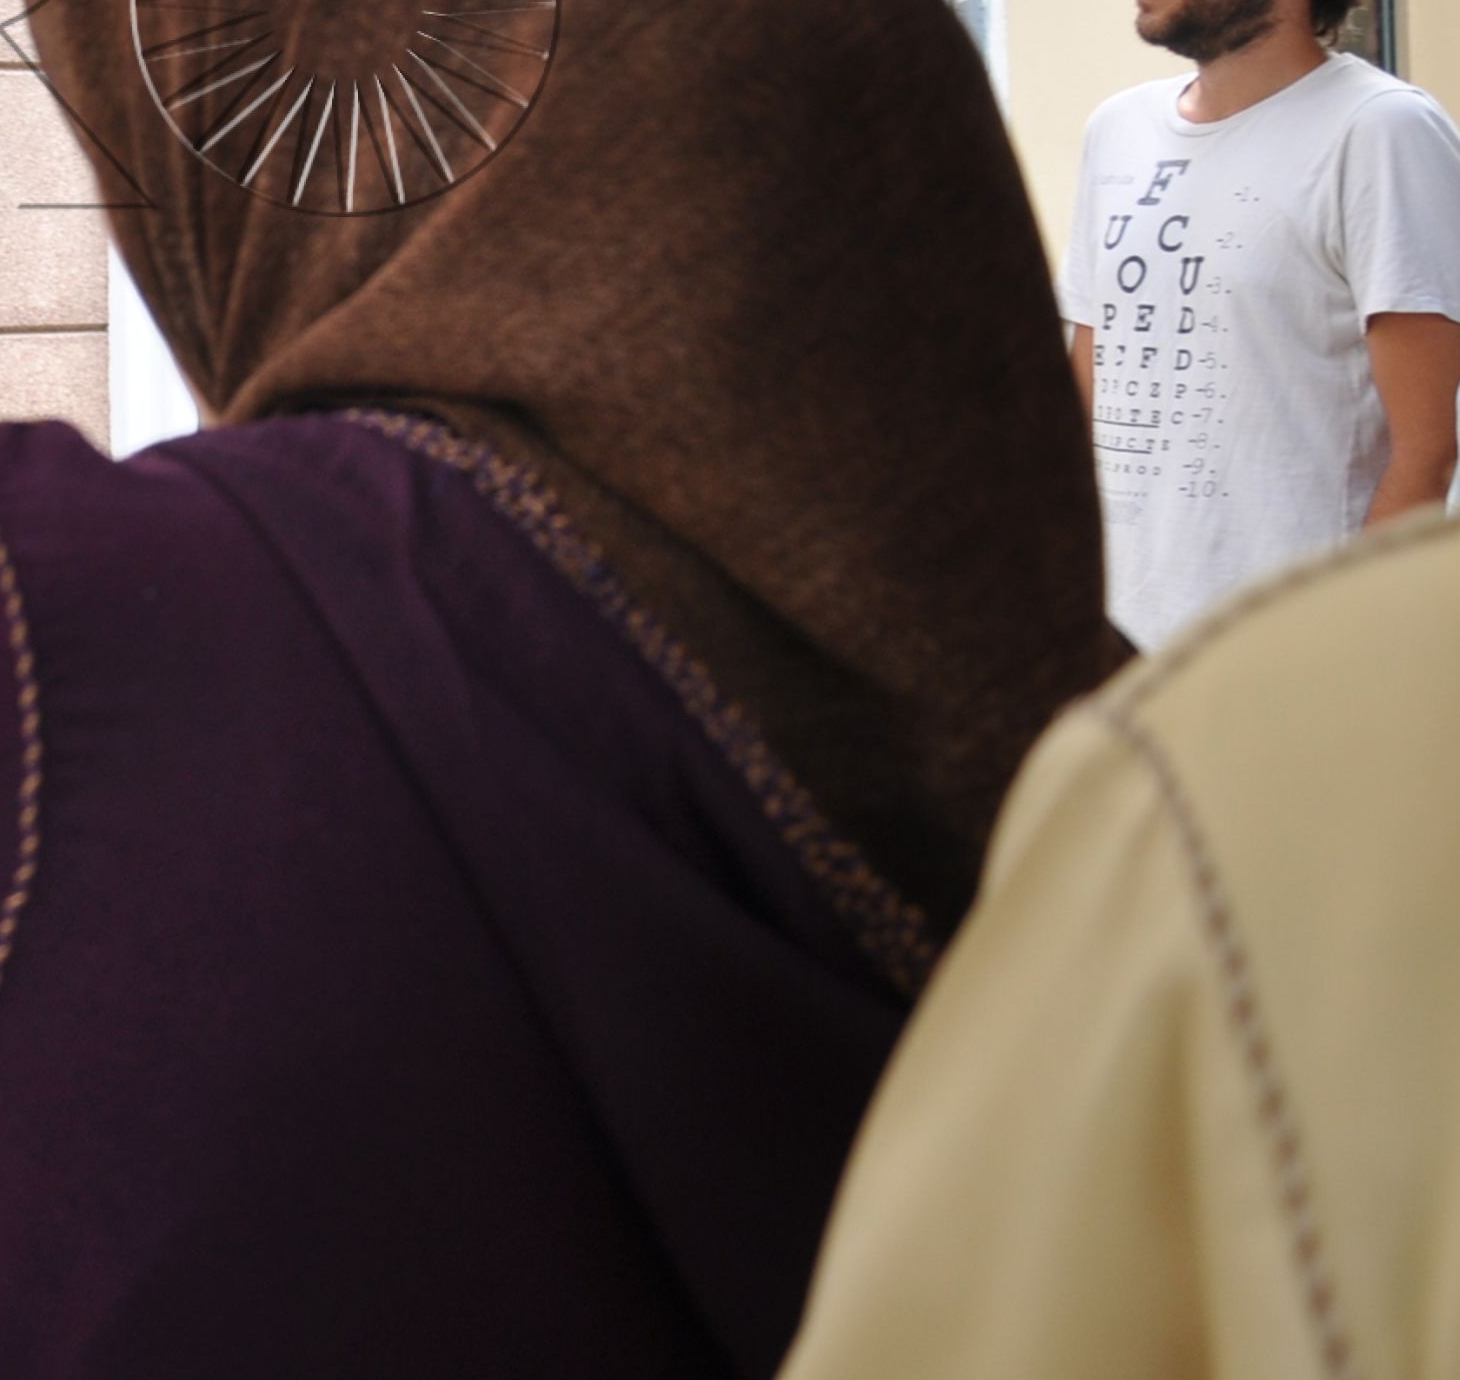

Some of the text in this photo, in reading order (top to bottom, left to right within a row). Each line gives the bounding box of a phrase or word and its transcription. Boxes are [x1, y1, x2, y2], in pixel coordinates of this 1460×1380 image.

[1136, 159, 1192, 206] F
[1104, 215, 1133, 250] U
[1157, 214, 1190, 252] C
[1116, 255, 1147, 294] O
[1179, 255, 1205, 296] U
[1102, 303, 1117, 331] P
[1133, 304, 1156, 332] E
[1177, 306, 1196, 334] D
[1140, 346, 1158, 369] F
[1173, 348, 1193, 371] D
[1125, 380, 1139, 397] C
[1171, 410, 1185, 425] C
